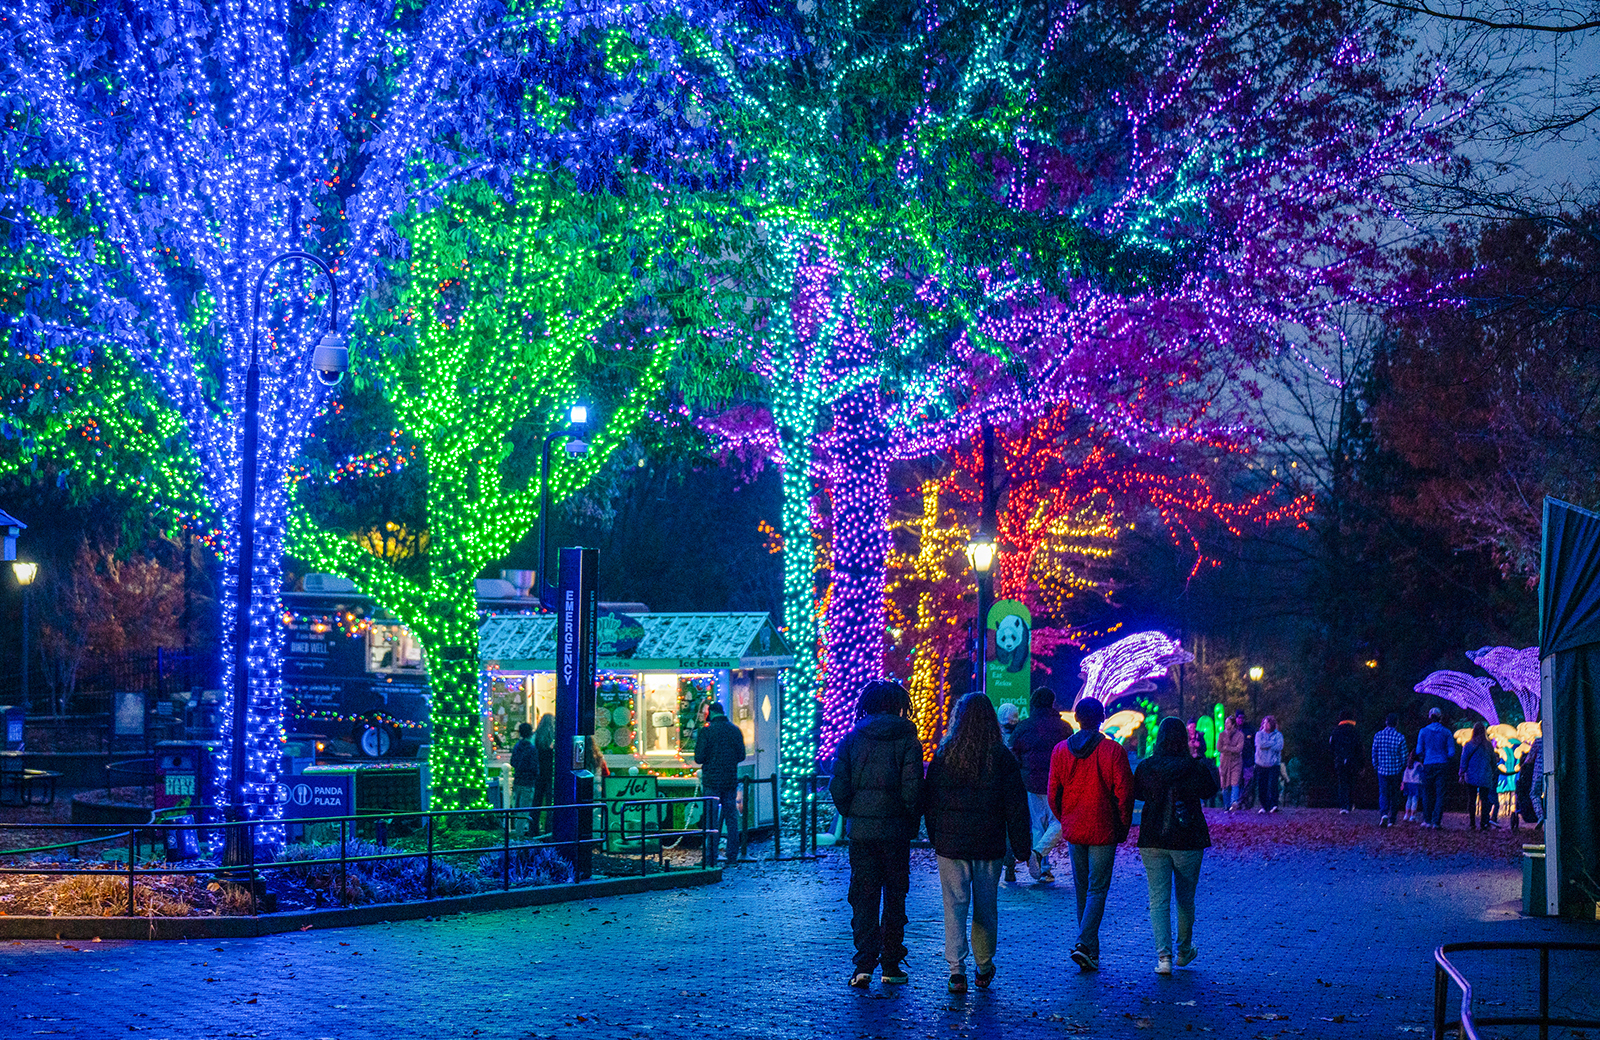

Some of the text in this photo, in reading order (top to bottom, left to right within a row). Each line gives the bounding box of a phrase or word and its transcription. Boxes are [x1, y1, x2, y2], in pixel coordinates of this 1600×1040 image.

[563, 590, 574, 685] EMERGENCY
[1000, 696, 1027, 705] panda
[165, 785, 195, 795] HERE
[314, 786, 343, 795] PANDA
[616, 779, 648, 797] Hot
[314, 798, 342, 806] PLAZA
